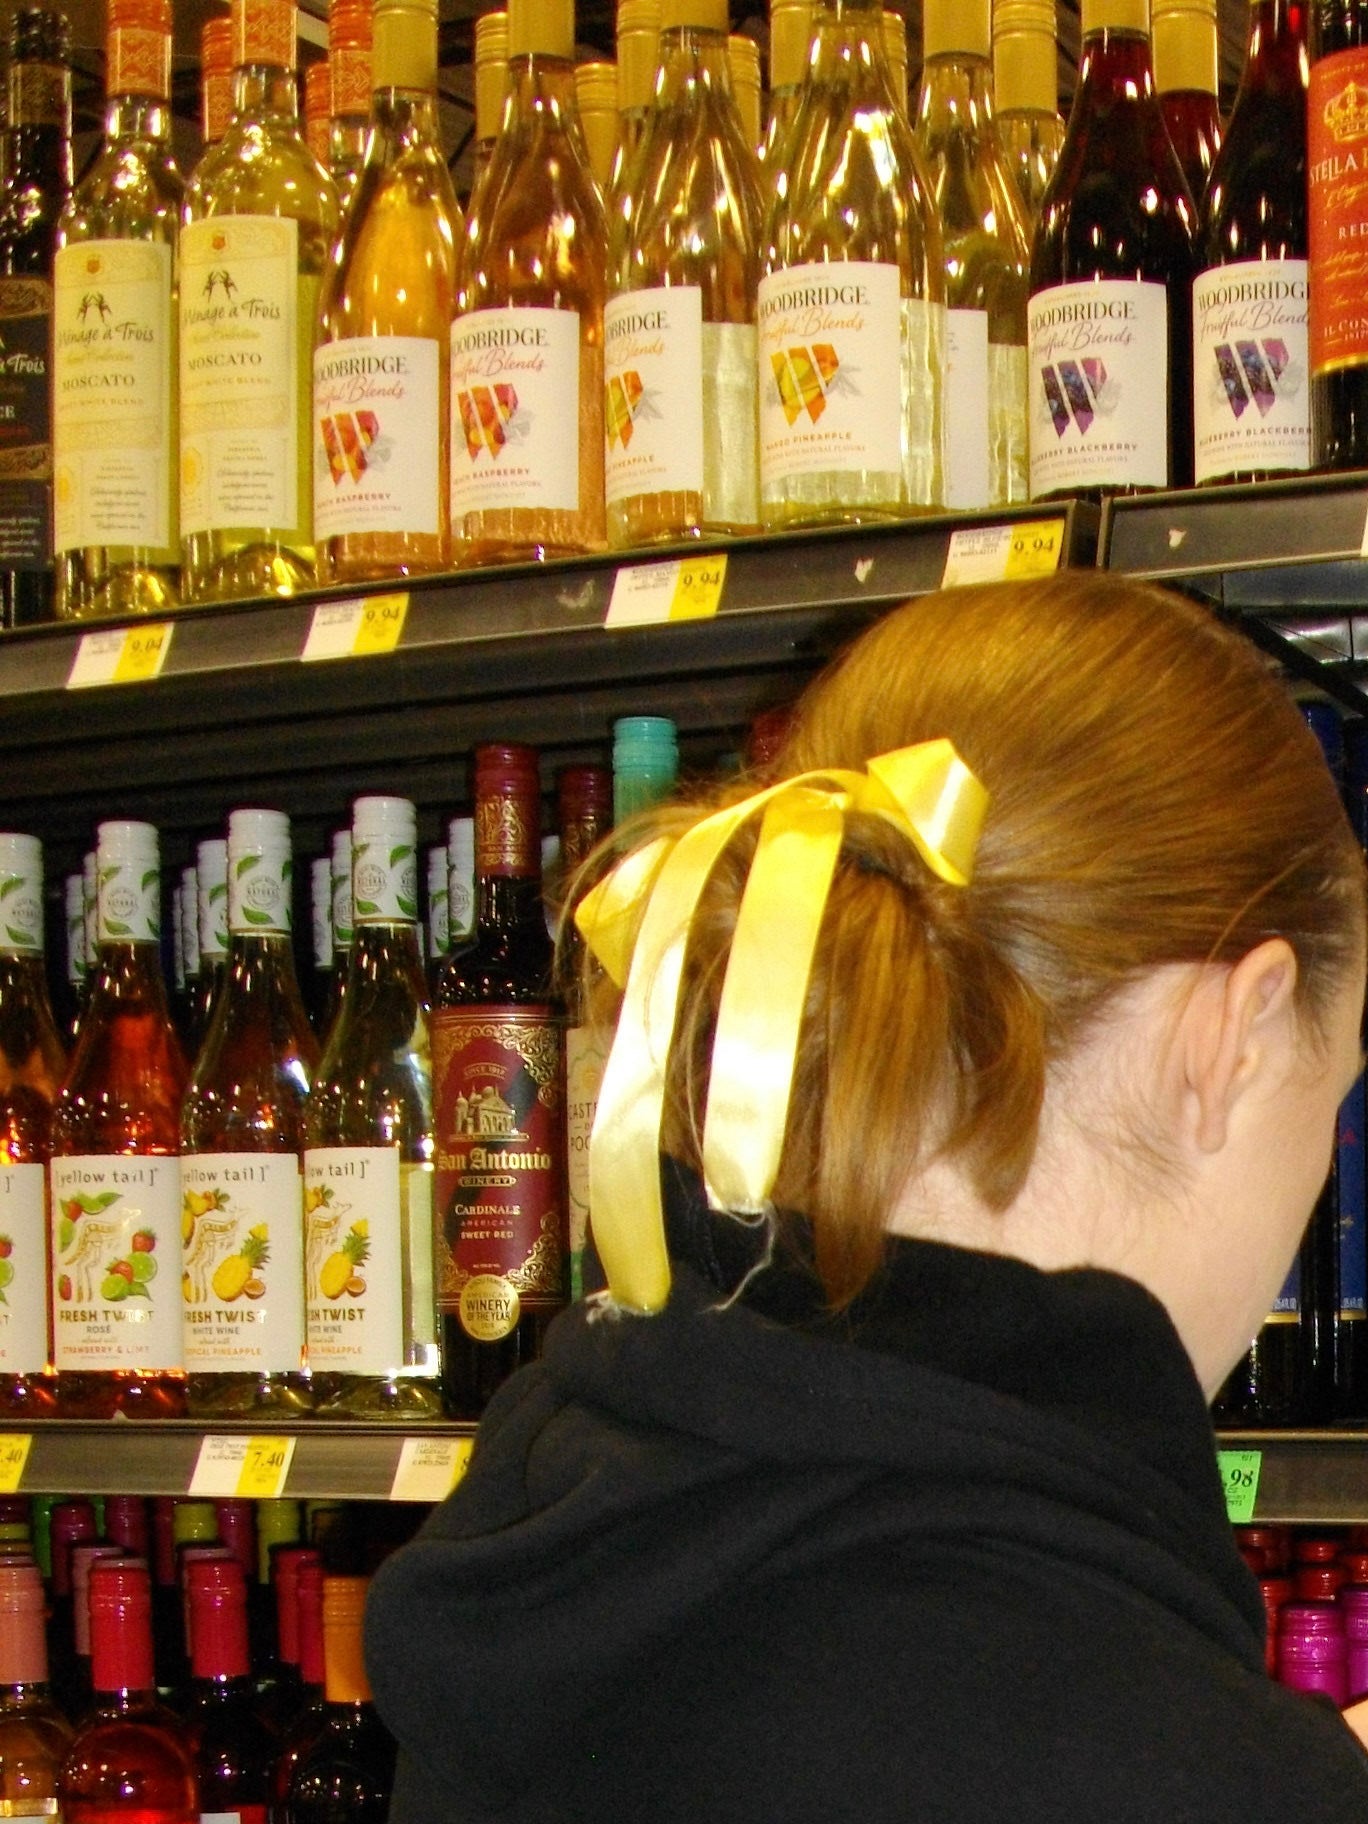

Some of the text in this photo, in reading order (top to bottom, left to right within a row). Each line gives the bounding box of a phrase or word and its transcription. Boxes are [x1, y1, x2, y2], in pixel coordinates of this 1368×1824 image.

[1310, 153, 1358, 186] STELLA
[188, 353, 262, 371] MOSCATO
[61, 374, 136, 392] MOSCATO
[1067, 443, 1138, 454] BLACKBERRY
[472, 468, 530, 479] RASPBERRY
[1014, 536, 1054, 554] 9.94
[683, 571, 720, 589] 9.94
[470, 1147, 550, 1171] Antonio
[467, 1299, 510, 1312] WINERY
[60, 1310, 98, 1322] FRESH
[323, 1309, 365, 1321] TWIST
[216, 1326, 240, 1335] WINE
[253, 1452, 284, 1468] 7.40
